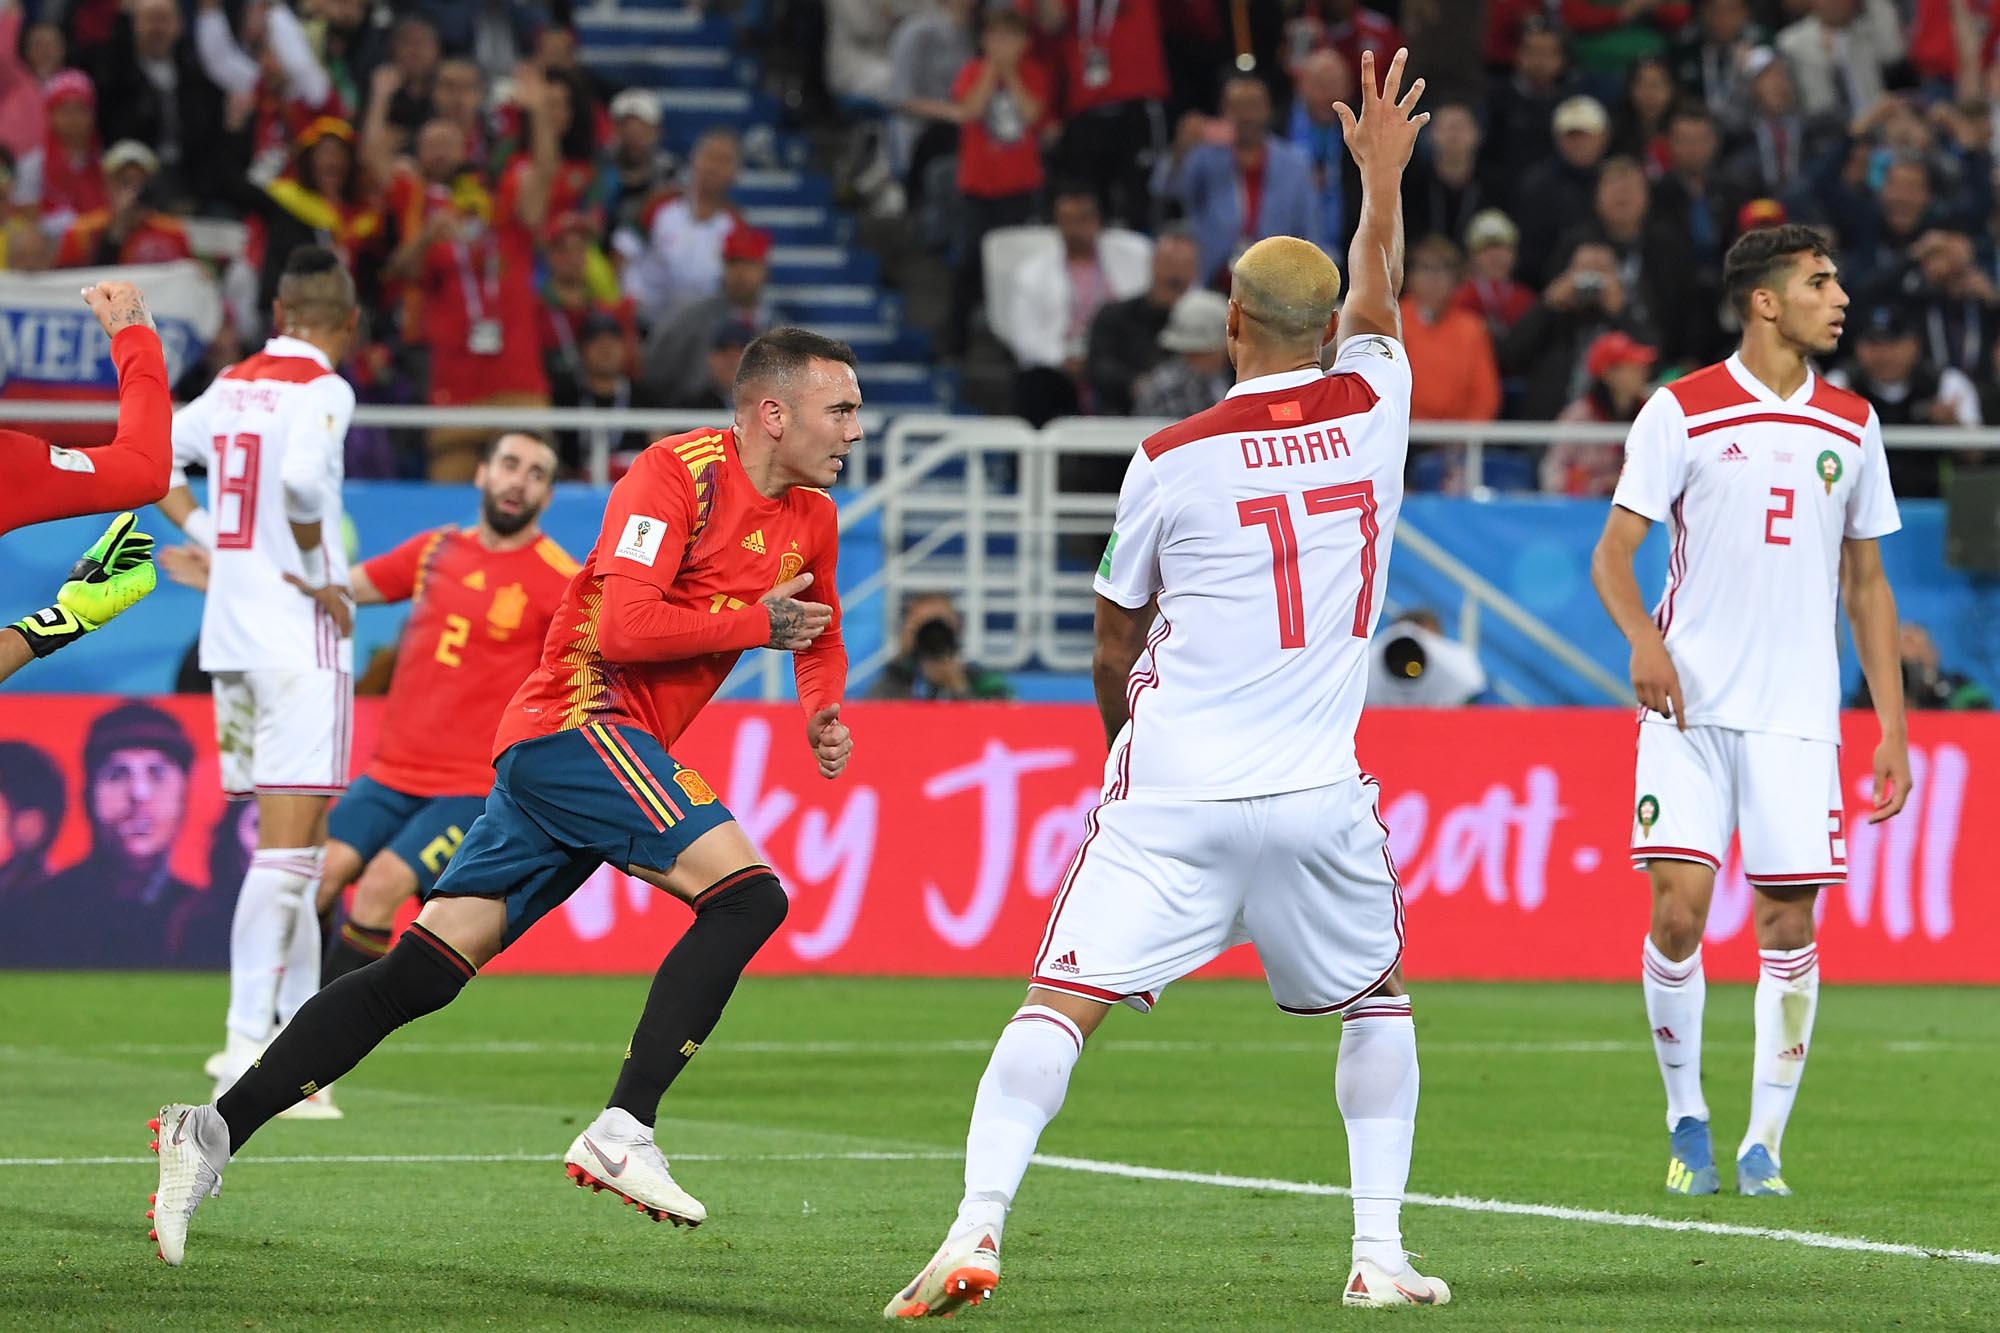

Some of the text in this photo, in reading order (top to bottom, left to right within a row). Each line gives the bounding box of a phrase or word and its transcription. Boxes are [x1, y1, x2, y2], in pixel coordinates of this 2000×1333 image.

[1240, 426, 1351, 469] DIRAR
[213, 432, 262, 549] 13
[1764, 486, 1795, 546] 2
[1236, 479, 1379, 649] 17
[434, 612, 472, 668] 2
